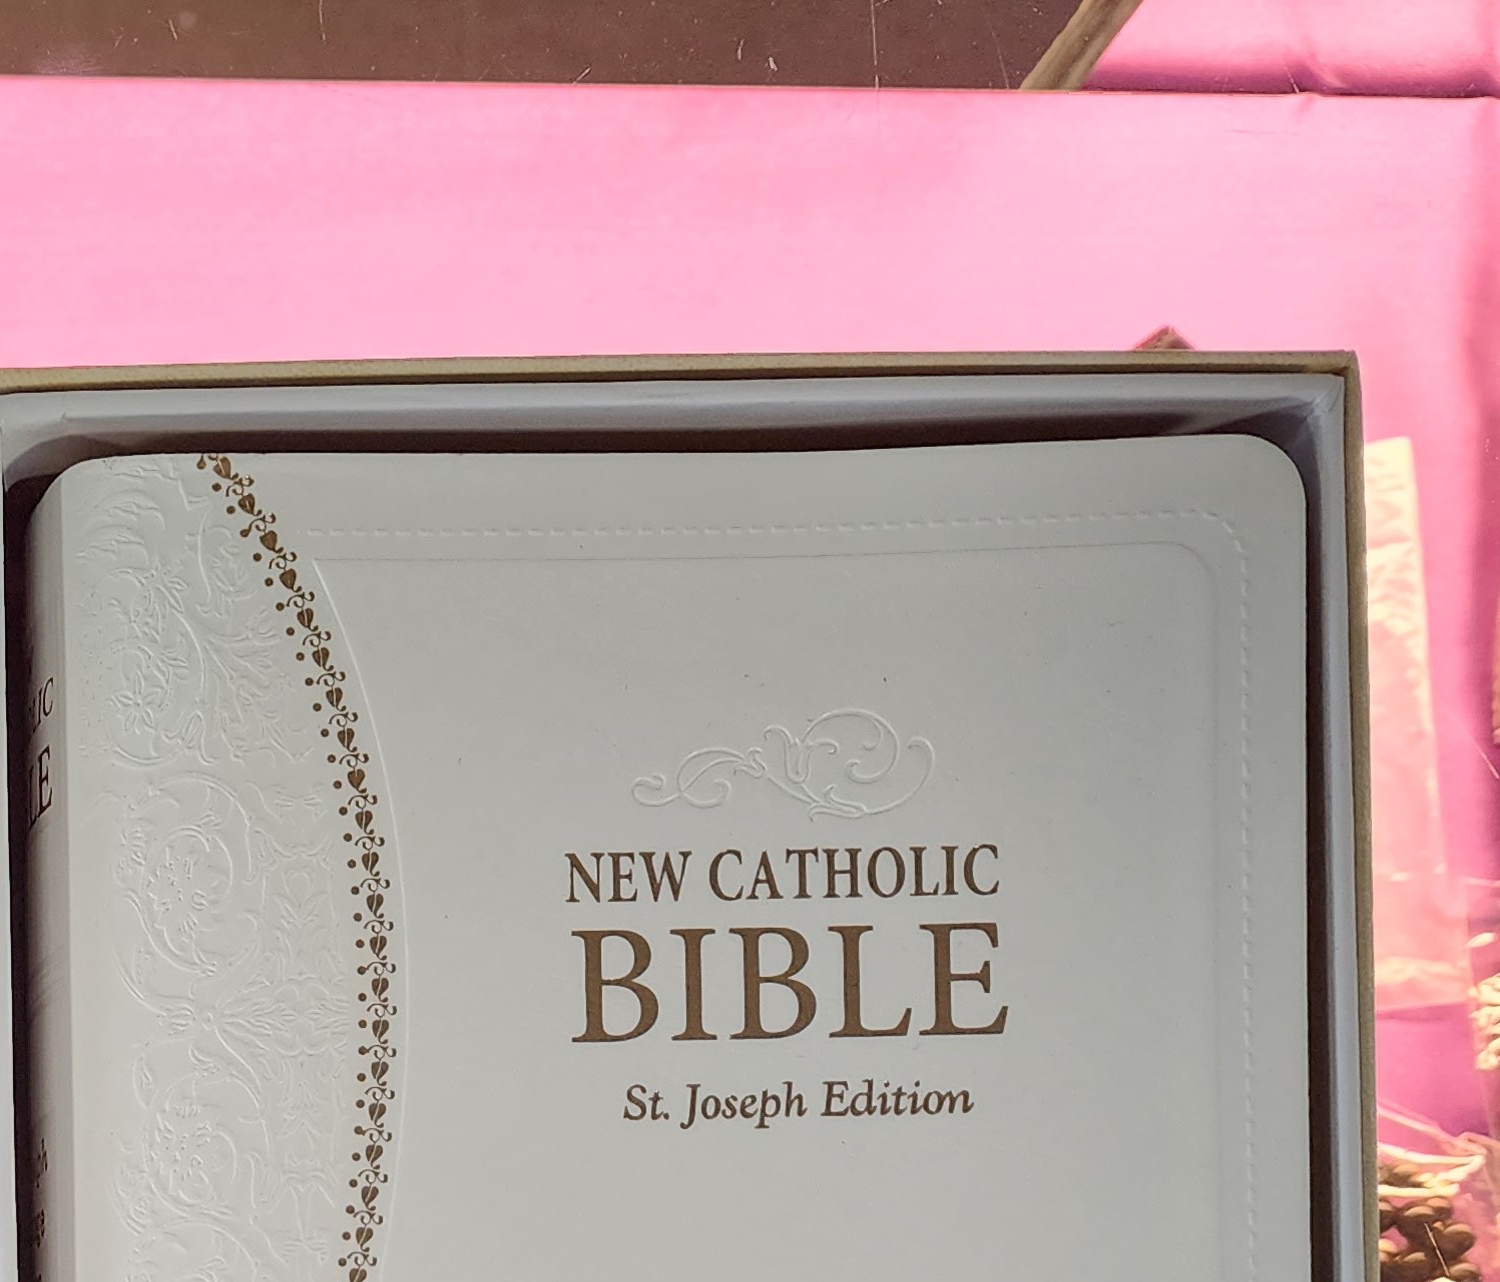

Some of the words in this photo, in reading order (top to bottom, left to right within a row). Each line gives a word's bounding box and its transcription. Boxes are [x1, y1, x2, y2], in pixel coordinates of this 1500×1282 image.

[564, 850, 693, 903] NEW
[708, 843, 1000, 901] CATHOLIC
[570, 922, 1009, 1043] BIBLE
[623, 1084, 671, 1121] St.
[679, 1080, 808, 1130] Joseph
[820, 1078, 975, 1117] Edition
